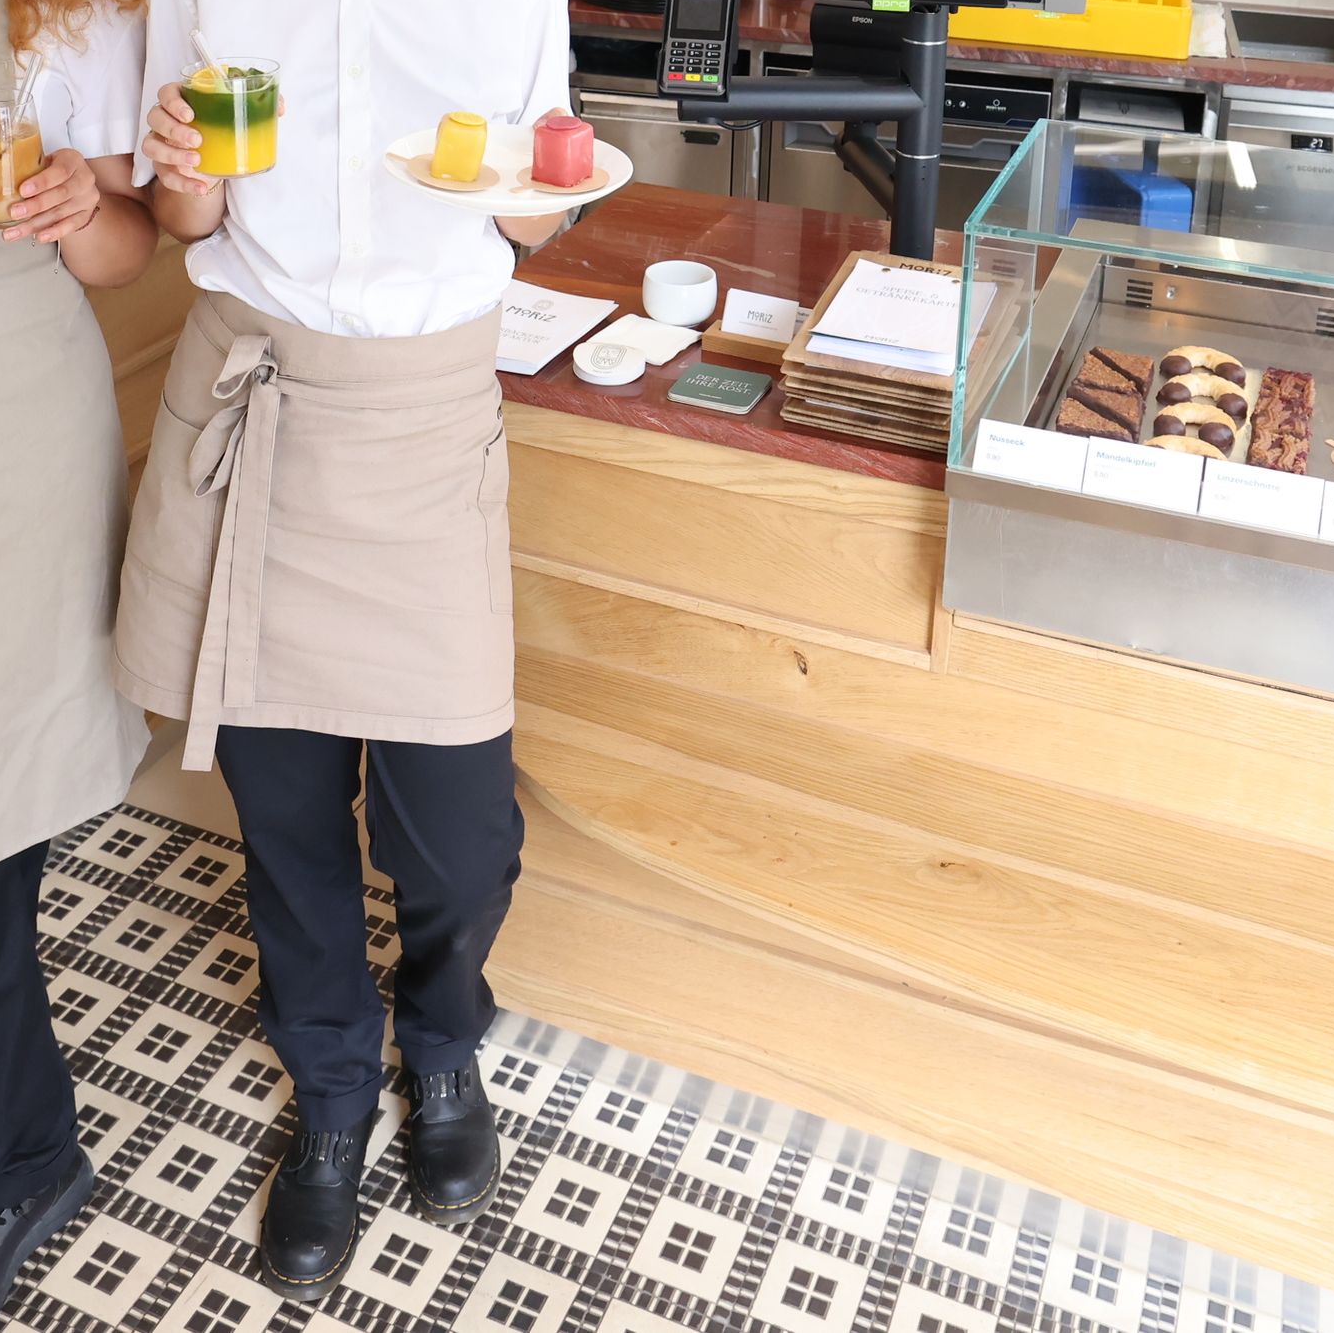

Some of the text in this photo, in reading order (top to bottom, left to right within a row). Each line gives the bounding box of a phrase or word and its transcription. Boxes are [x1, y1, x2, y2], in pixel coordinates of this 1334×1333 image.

[852, 16, 872, 24] EPSON
[686, 377, 716, 387] IHRE
[696, 374, 720, 383] DER
[989, 433, 1025, 446] Nusseck
[1096, 450, 1156, 468] Mandelkipferl
[1217, 473, 1281, 491] Linzerschnitte
